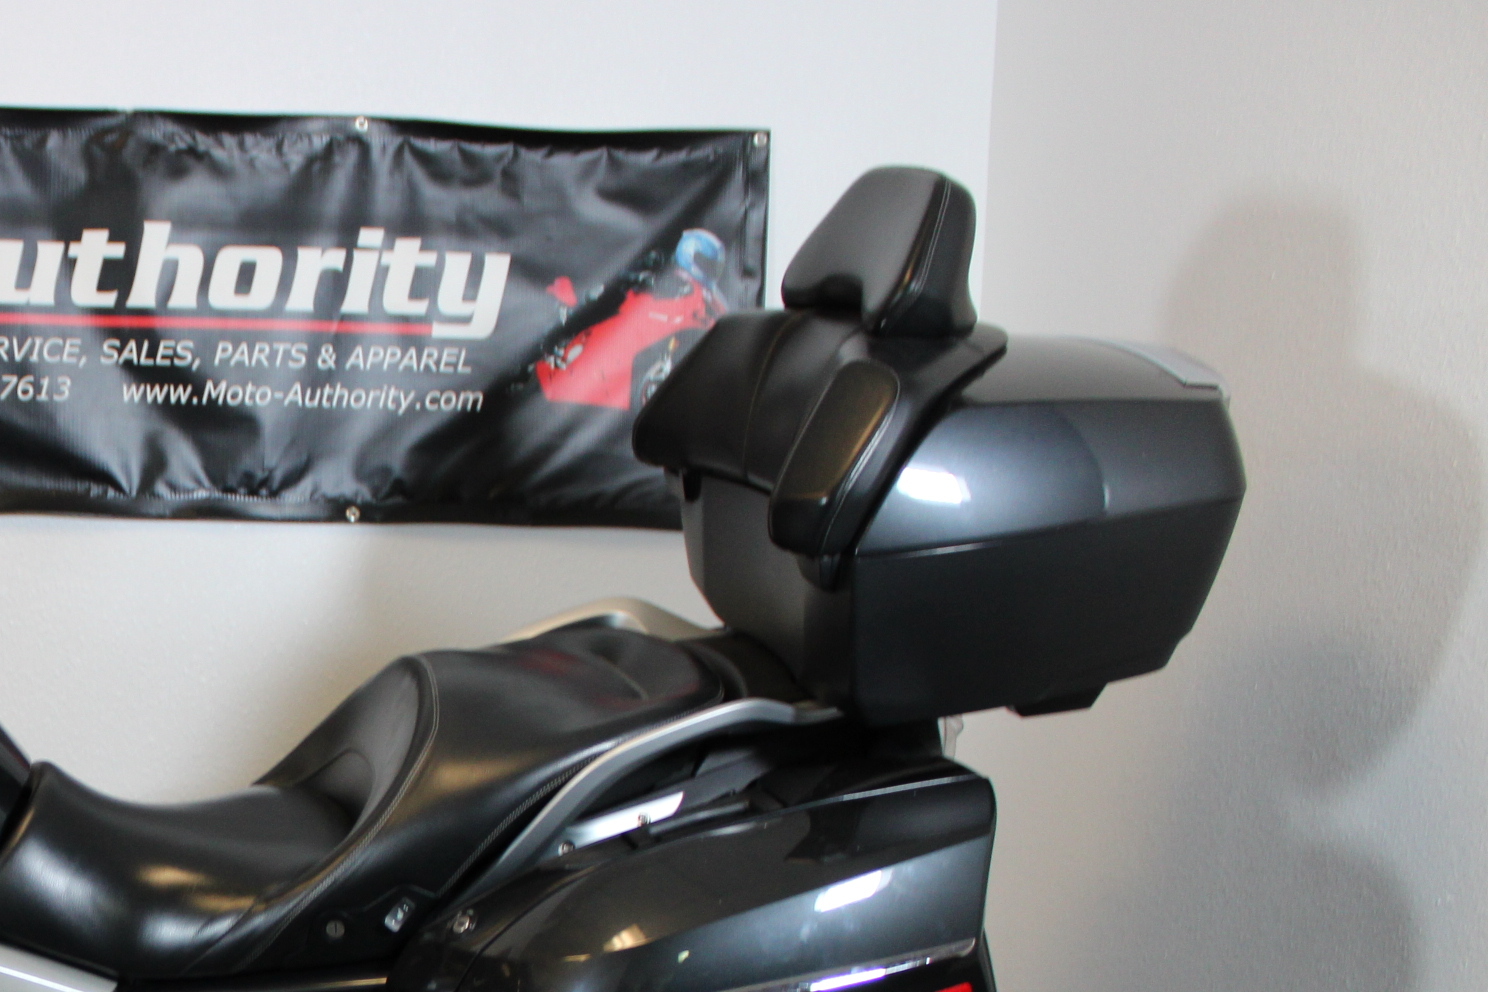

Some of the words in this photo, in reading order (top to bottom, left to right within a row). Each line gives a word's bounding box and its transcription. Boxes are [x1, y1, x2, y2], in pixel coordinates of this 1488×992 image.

[100, 338, 201, 371] SALES,
[214, 340, 308, 369] PARTS
[317, 342, 338, 370] &
[345, 345, 473, 375] APPAREL
[122, 379, 485, 415] www.Moto-Authority.com
